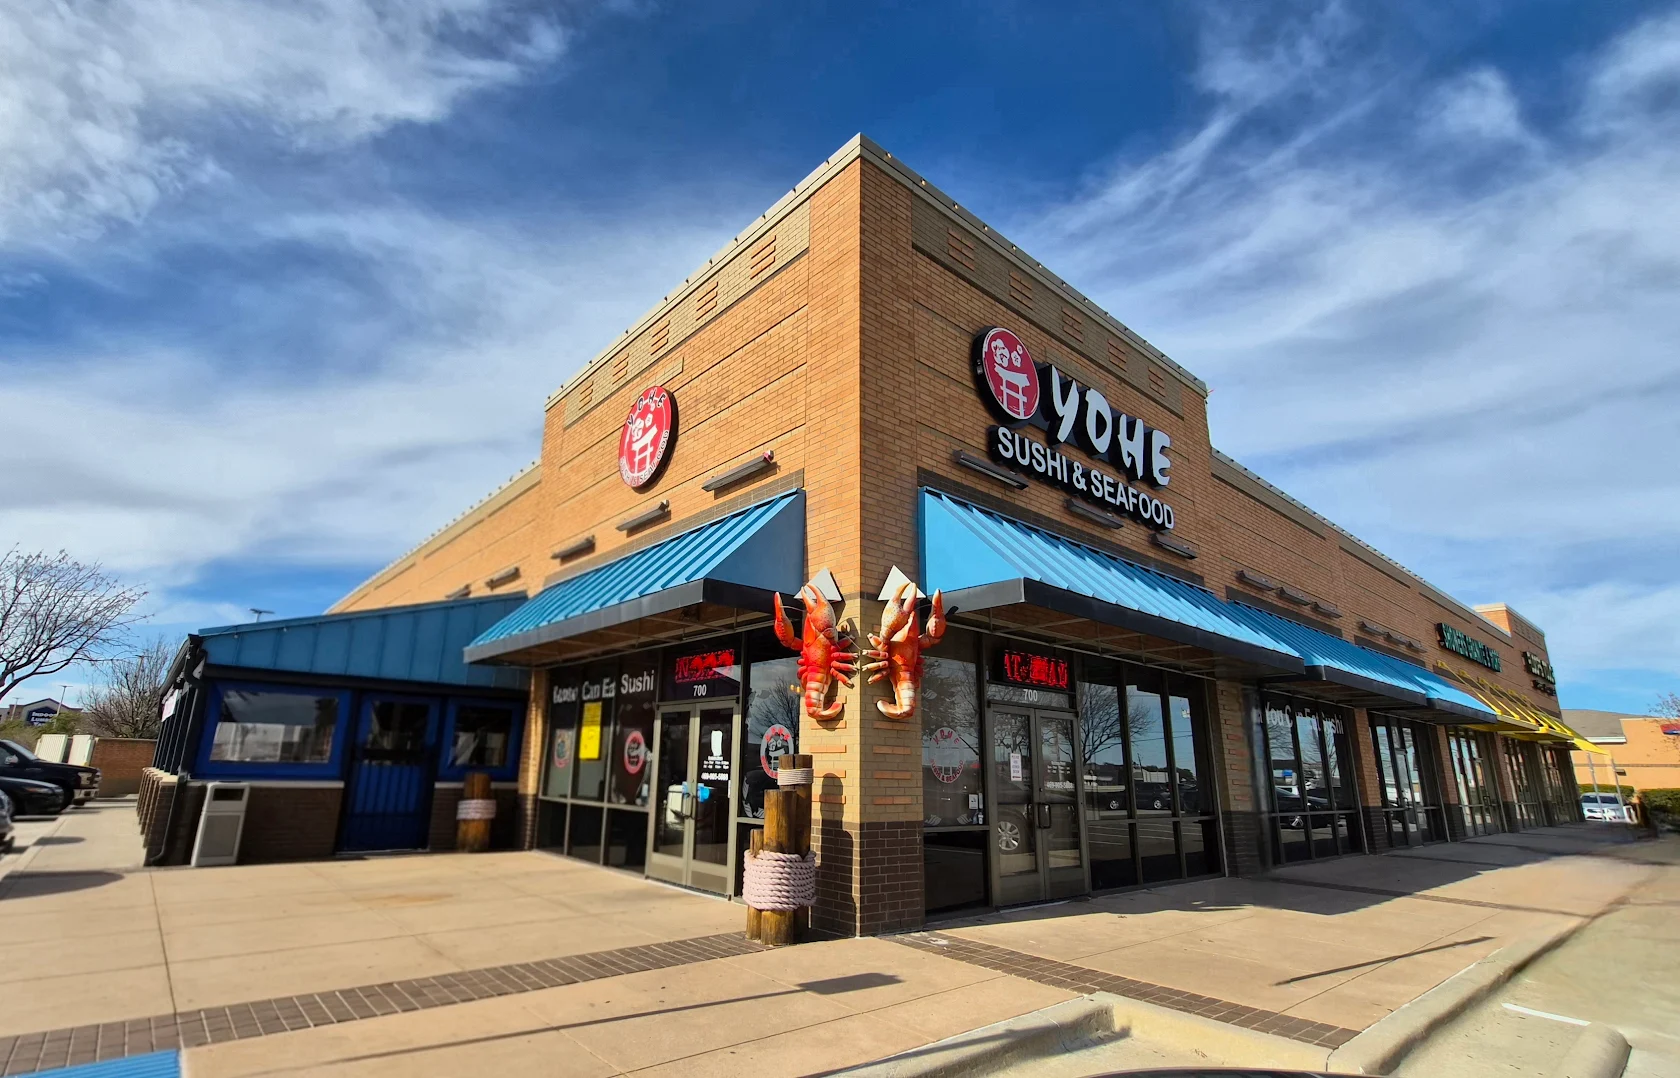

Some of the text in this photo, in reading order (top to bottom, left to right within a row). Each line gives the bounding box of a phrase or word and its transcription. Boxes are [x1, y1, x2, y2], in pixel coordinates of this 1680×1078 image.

[627, 387, 667, 426] YOHE
[1052, 364, 1171, 486] YOHE
[998, 427, 1175, 530] SUSHI & SEAFOOD
[602, 677, 616, 698] Ea
[620, 670, 654, 694] Sushi
[693, 684, 707, 697] 700
[1023, 689, 1038, 701] 700
[933, 729, 960, 744] YOHE
